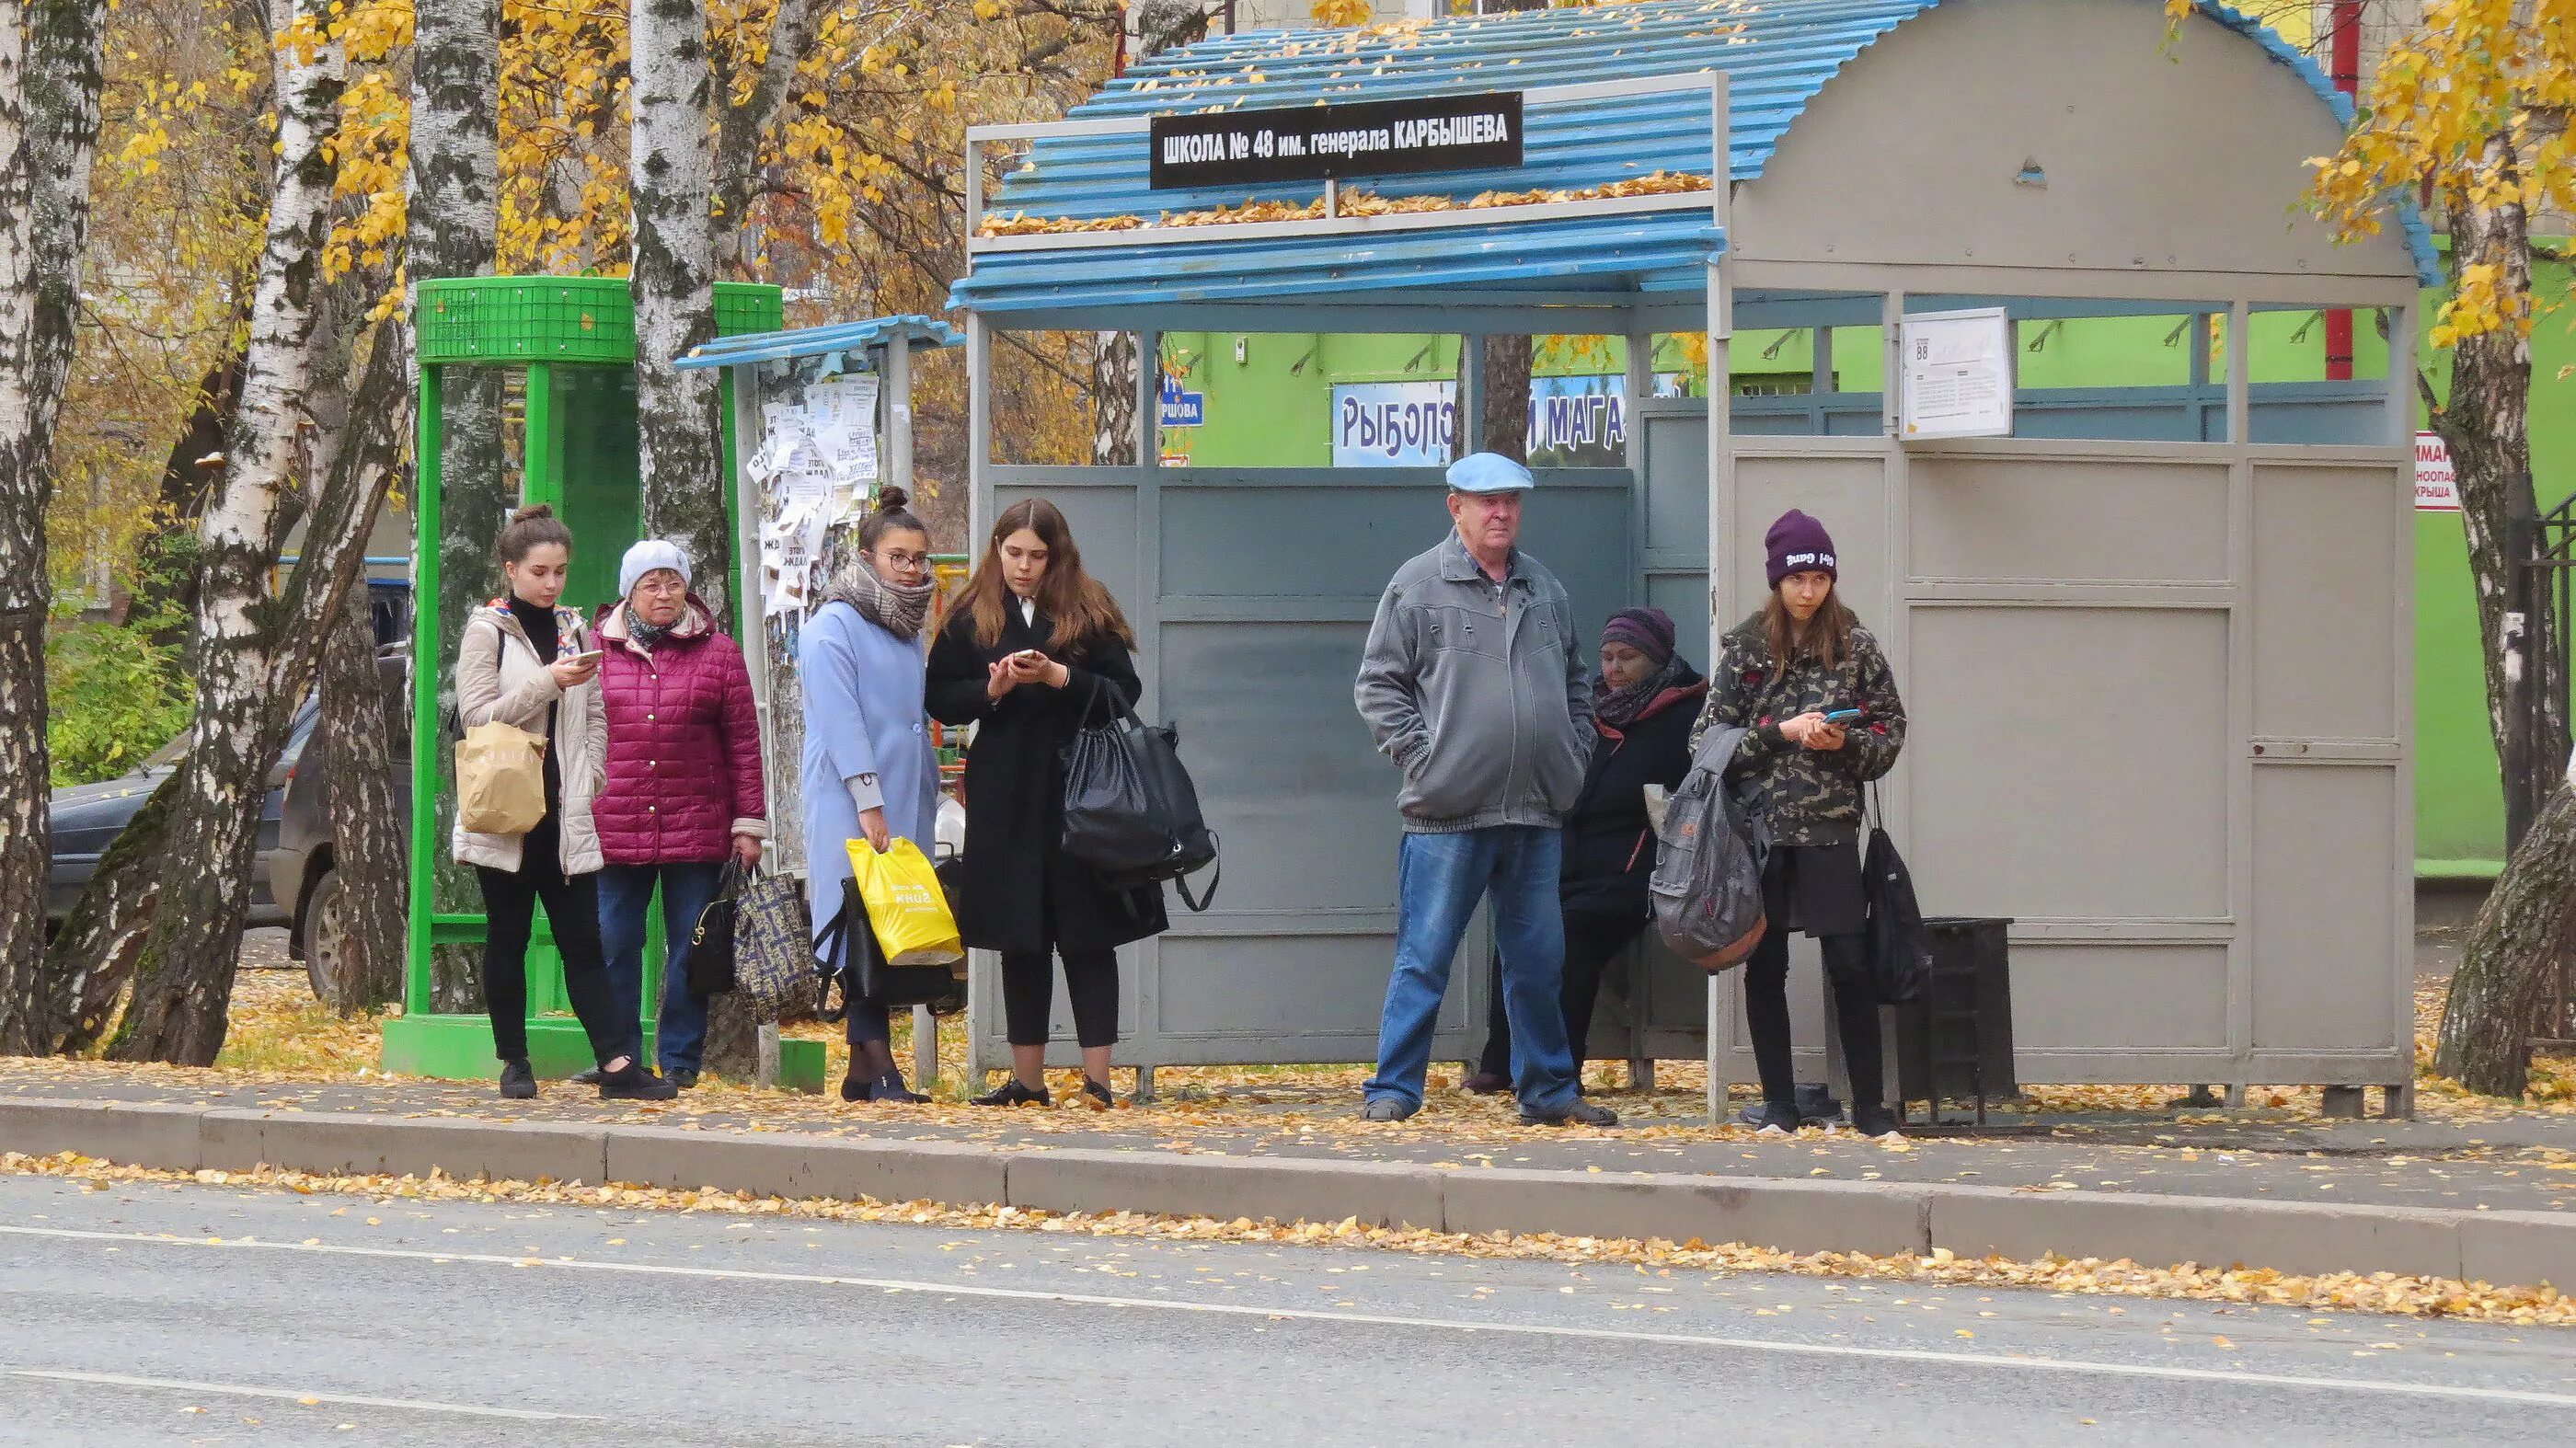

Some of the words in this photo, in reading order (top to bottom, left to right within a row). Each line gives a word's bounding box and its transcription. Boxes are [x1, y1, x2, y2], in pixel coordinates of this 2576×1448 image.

[1163, 133, 1224, 164] ШКОЛА
[1229, 132, 1248, 160] №
[1253, 130, 1273, 157] 48
[1278, 137, 1305, 156] им.
[1310, 129, 1389, 158] генерала
[1394, 113, 1507, 148] КАРБЫШЕВА
[1916, 346, 1928, 360] 88
[1162, 404, 1198, 418] РШОВА
[1547, 396, 1627, 451] МАГА
